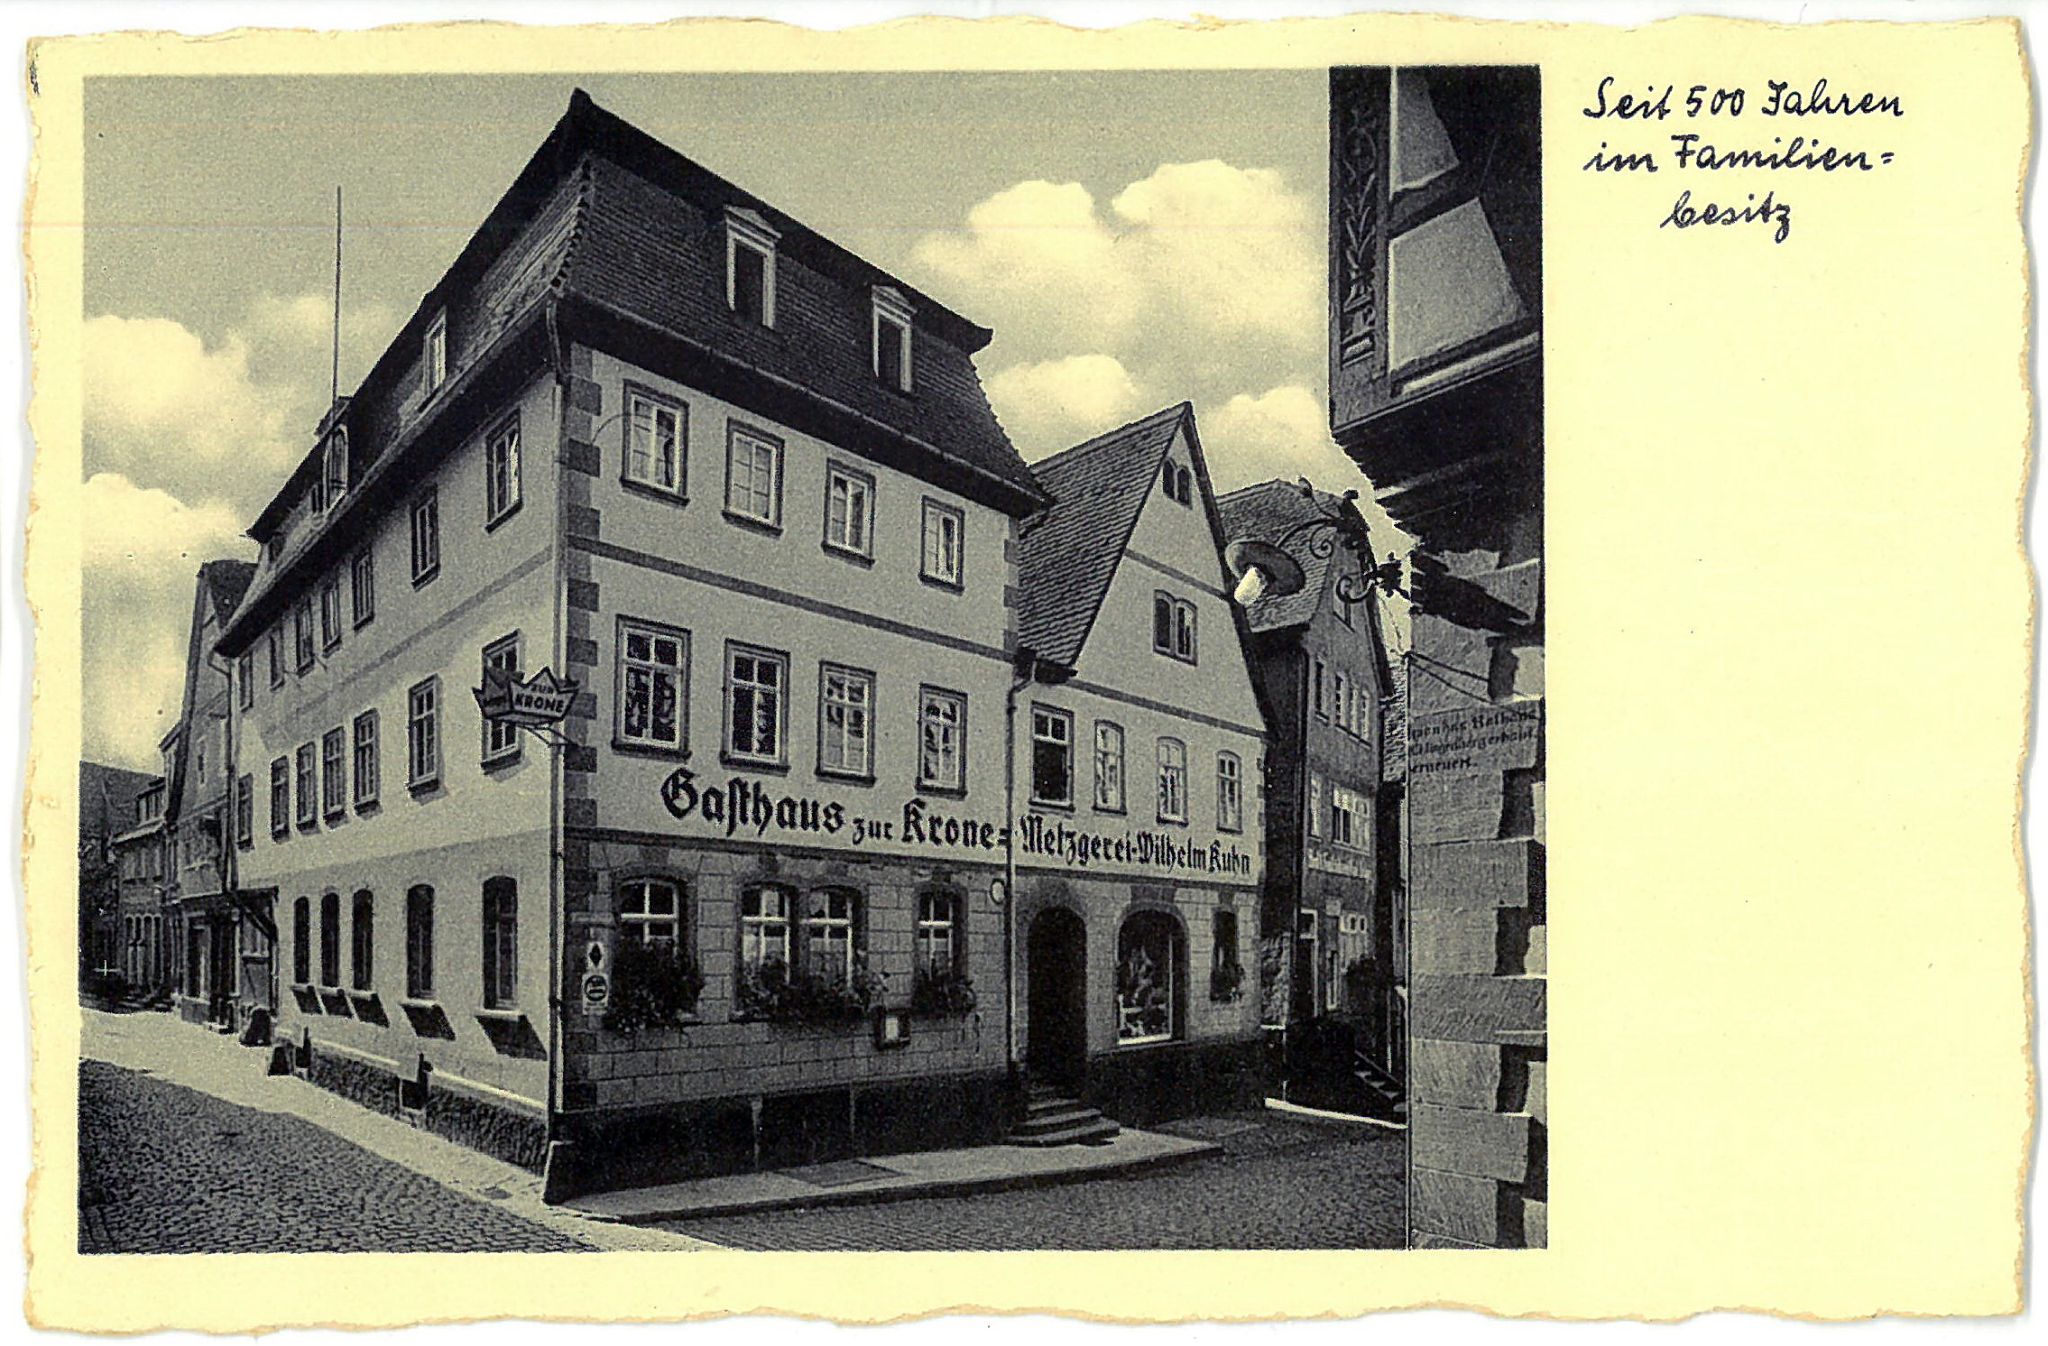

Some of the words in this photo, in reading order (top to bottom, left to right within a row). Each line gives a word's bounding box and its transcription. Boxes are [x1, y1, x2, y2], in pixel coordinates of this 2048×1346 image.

[513, 692, 565, 714] KRONE
[660, 766, 847, 838] Gasthaus
[852, 817, 895, 845] zur
[1208, 838, 1251, 877] Kuhn
